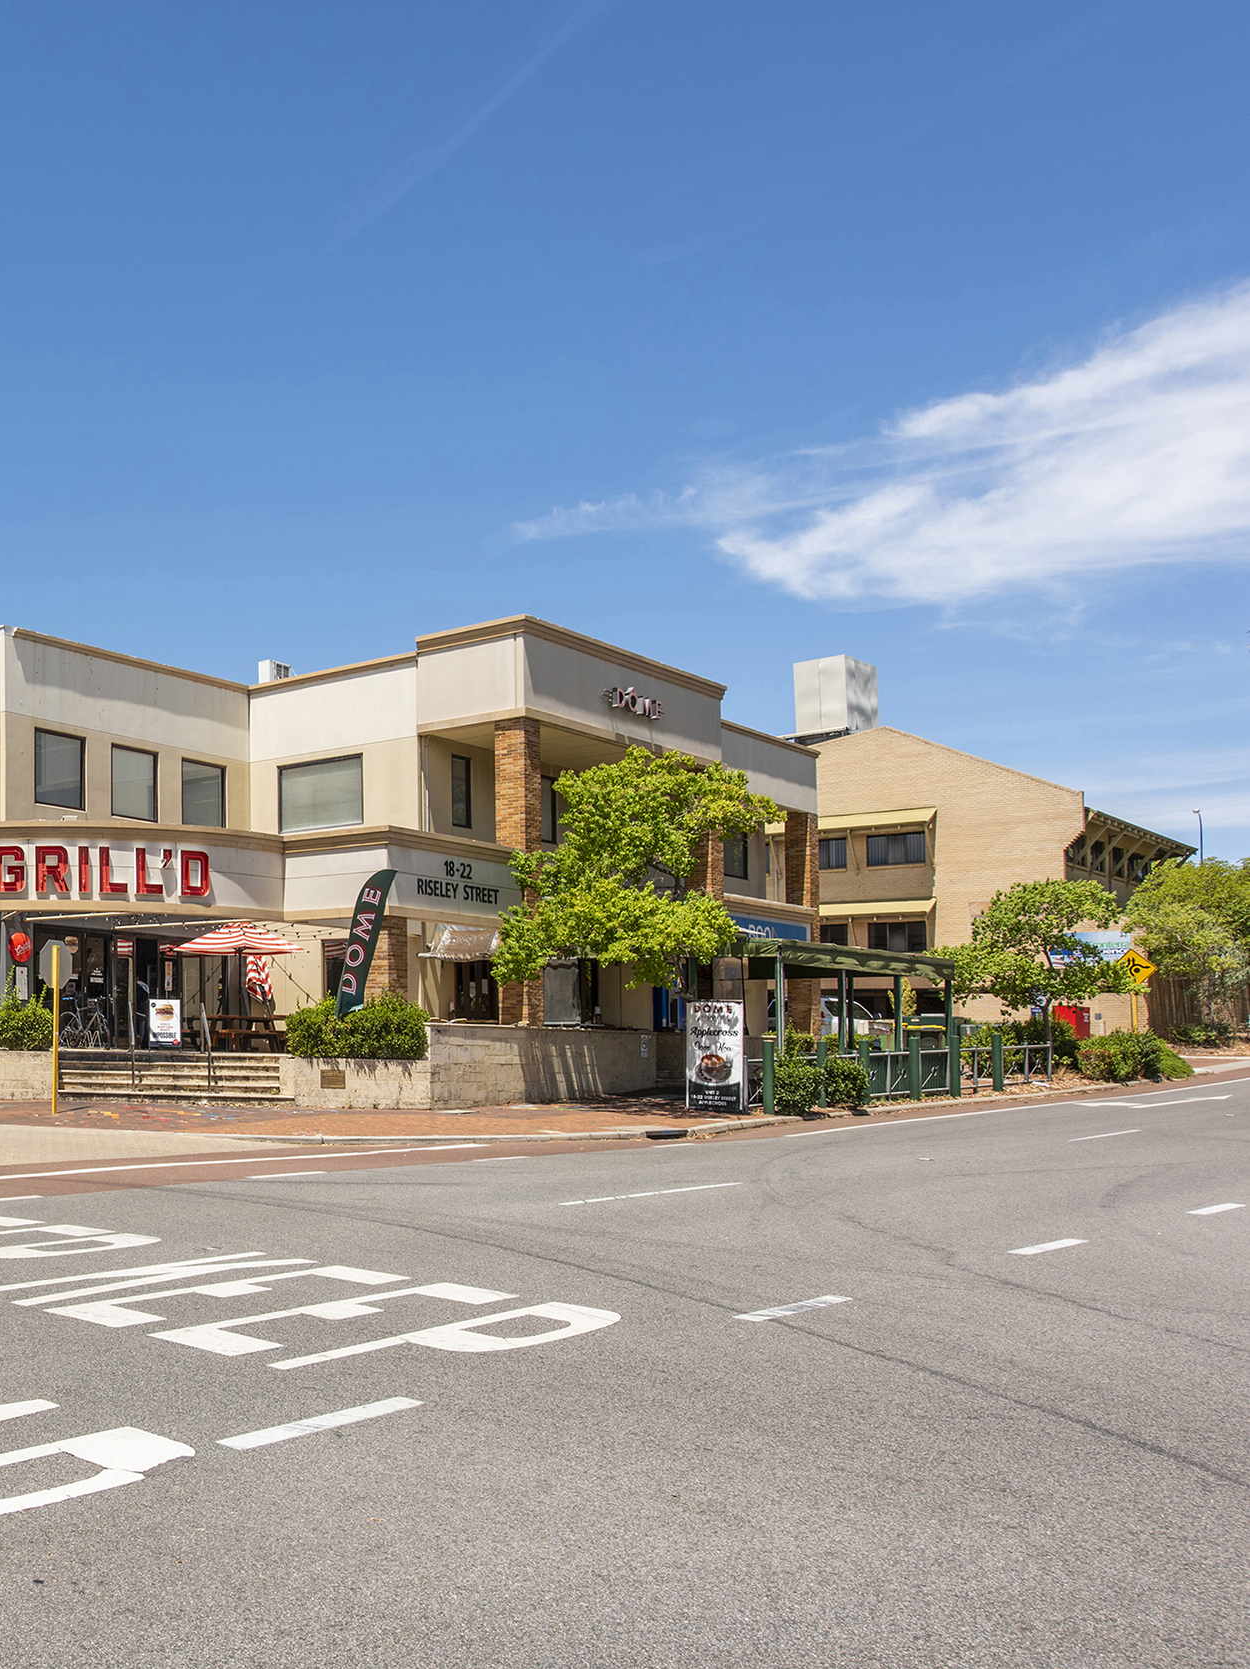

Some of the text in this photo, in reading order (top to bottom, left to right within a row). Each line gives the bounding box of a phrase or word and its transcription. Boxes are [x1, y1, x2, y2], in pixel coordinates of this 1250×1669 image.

[444, 860, 473, 880] 18-22
[417, 878, 499, 904] RISELEY STREET
[341, 885, 382, 996] DOME
[690, 1027, 739, 1038] Applecross
